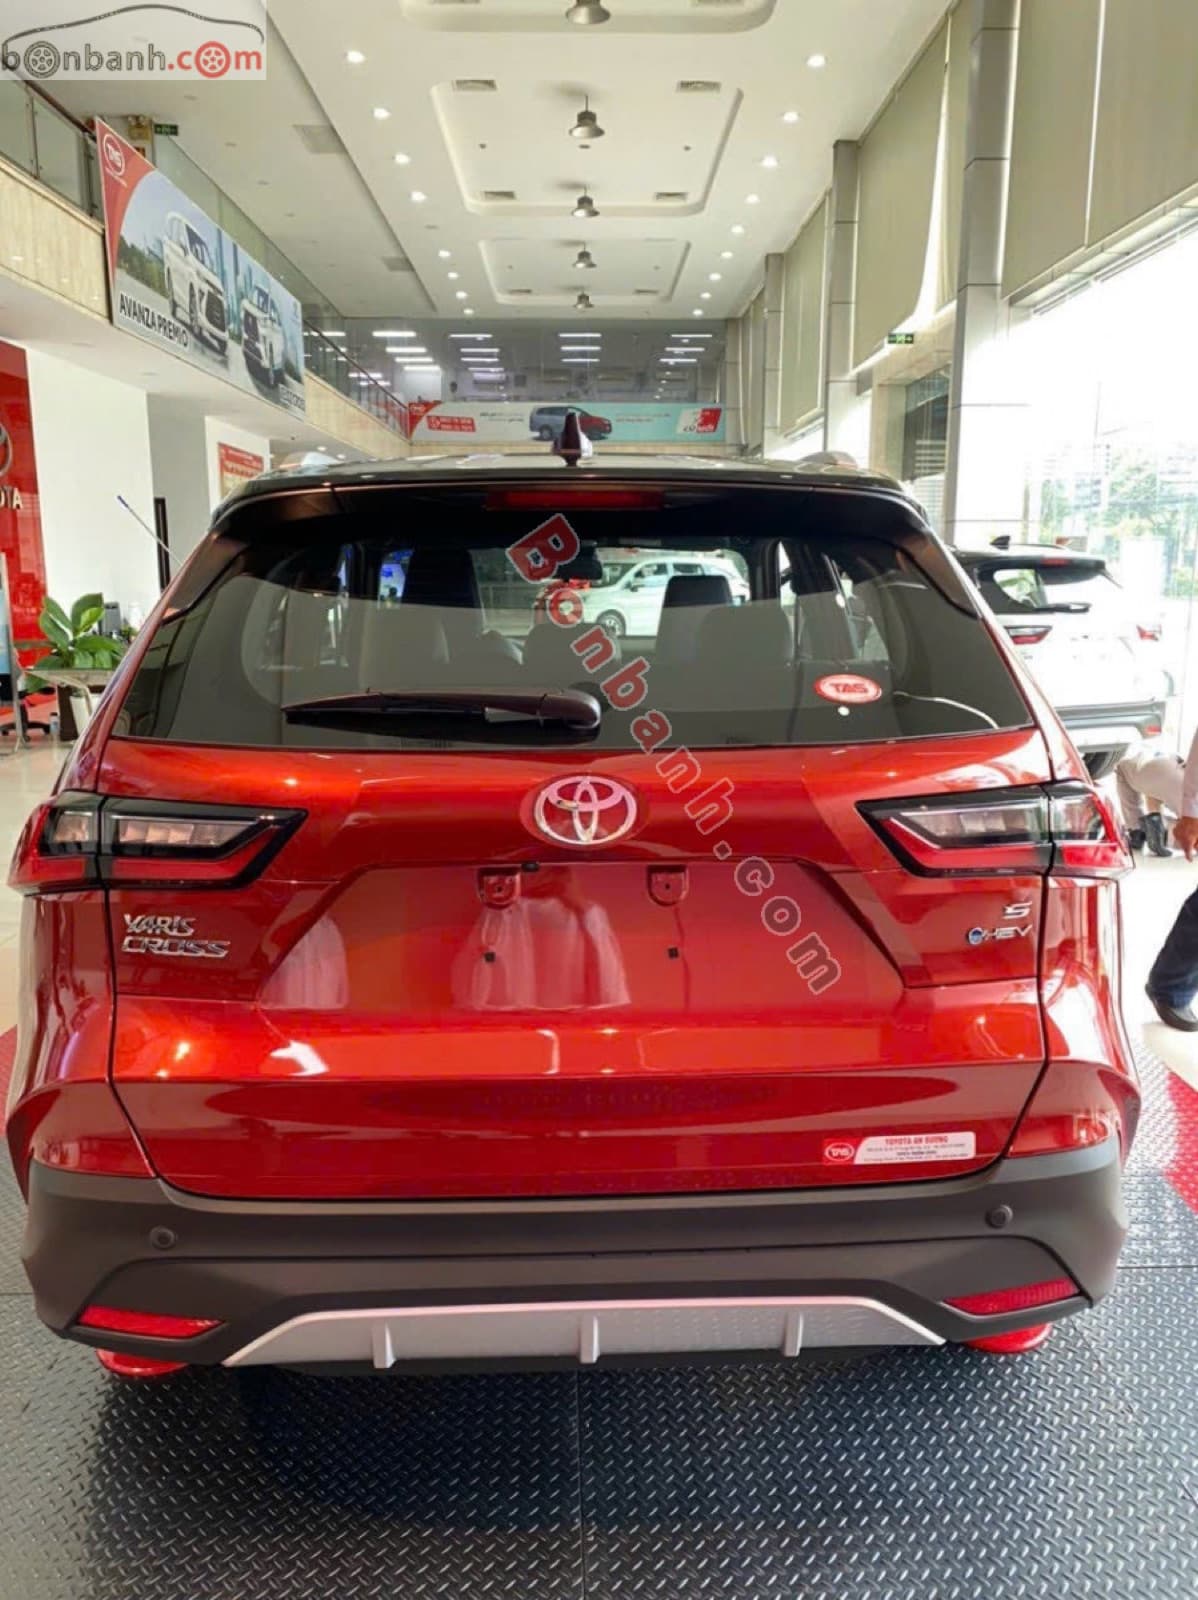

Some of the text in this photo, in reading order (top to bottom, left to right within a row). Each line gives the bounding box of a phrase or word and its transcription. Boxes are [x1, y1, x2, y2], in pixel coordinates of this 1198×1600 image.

[119, 292, 189, 348] AVANZA PREMIO
[1002, 900, 1033, 920] S
[123, 913, 197, 936] YARIS
[122, 935, 231, 958] CROSS
